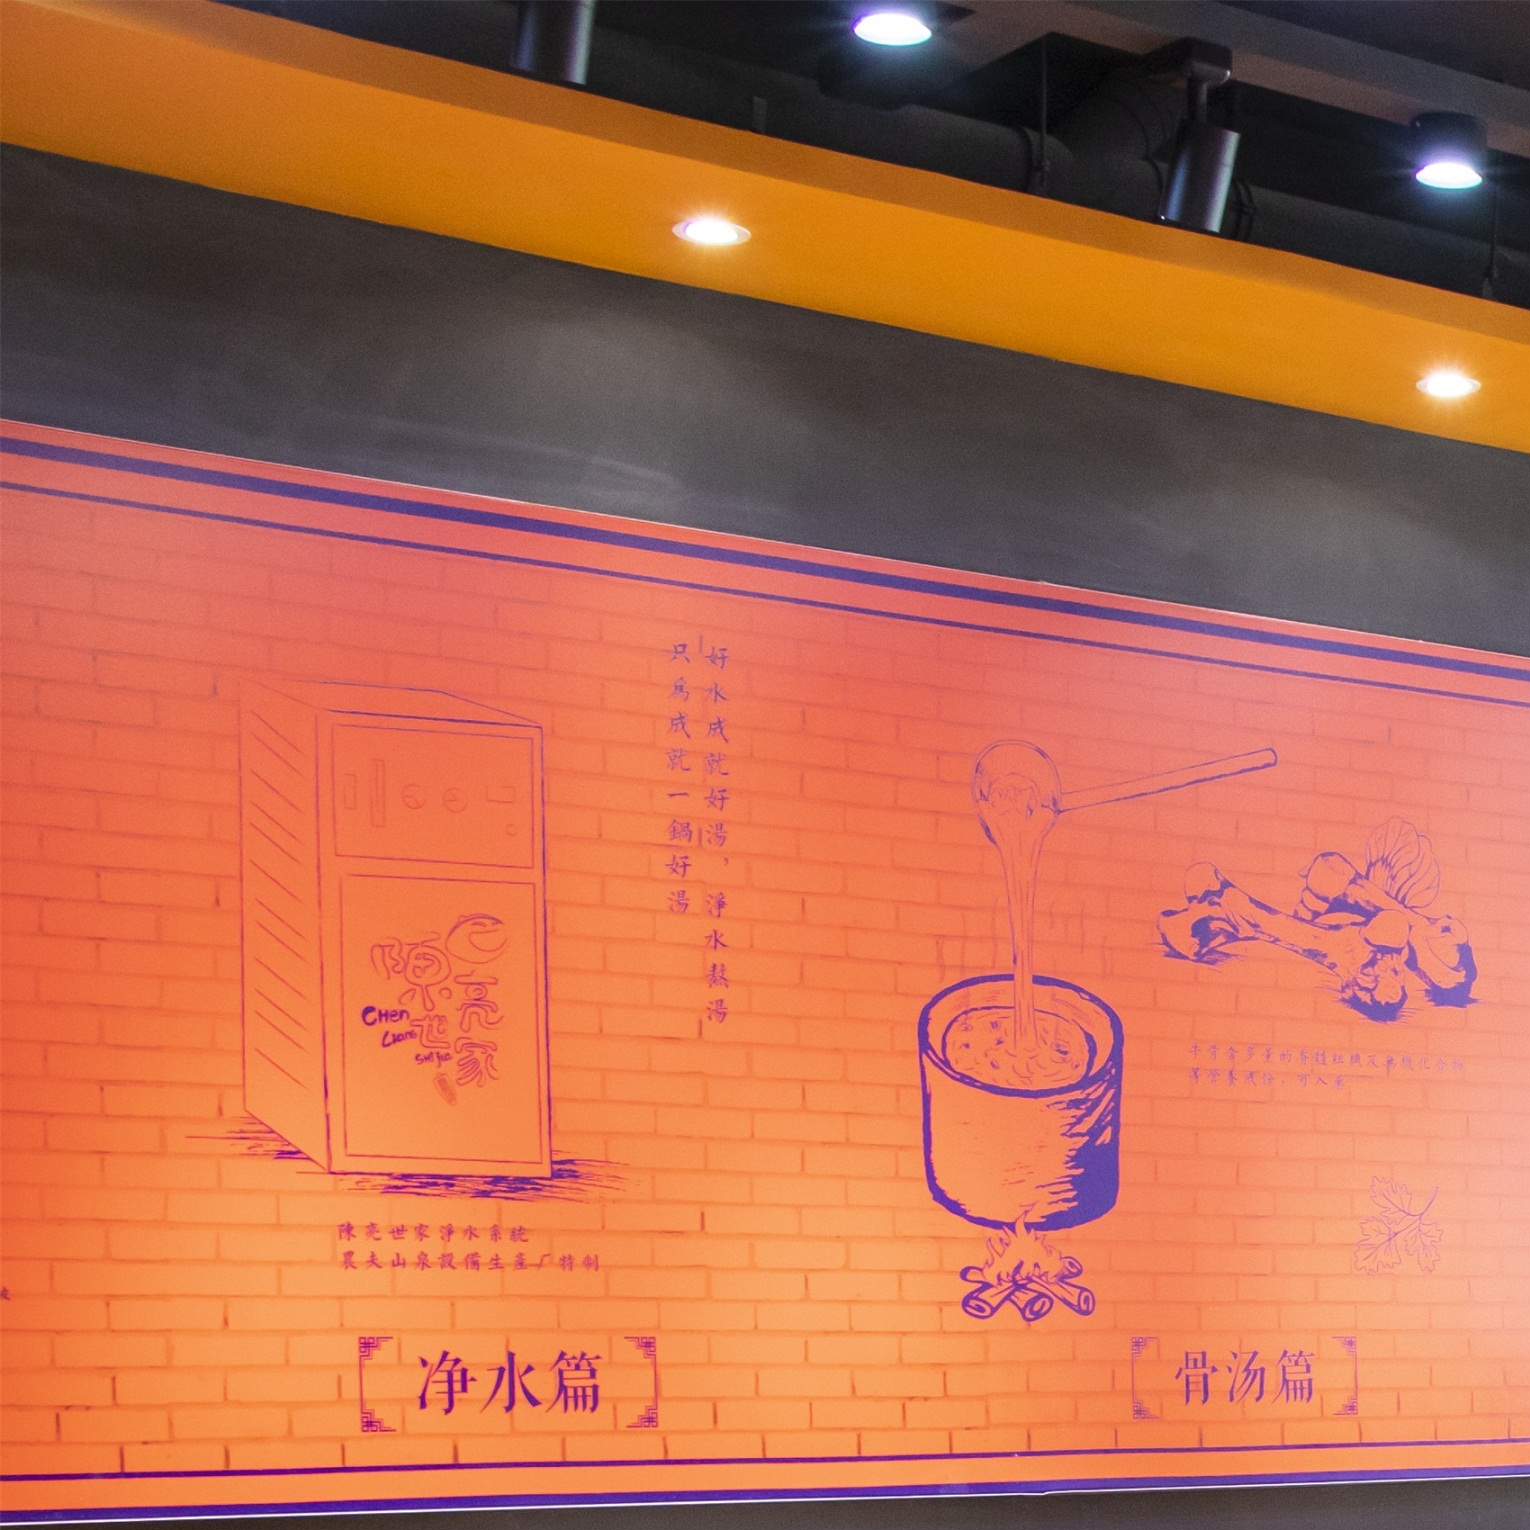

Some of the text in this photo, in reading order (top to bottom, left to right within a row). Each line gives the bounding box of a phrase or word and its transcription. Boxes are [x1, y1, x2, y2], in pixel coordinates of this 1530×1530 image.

[416, 1349, 604, 1416] 净水篇
[1173, 1347, 1317, 1407] 骨汤篇
